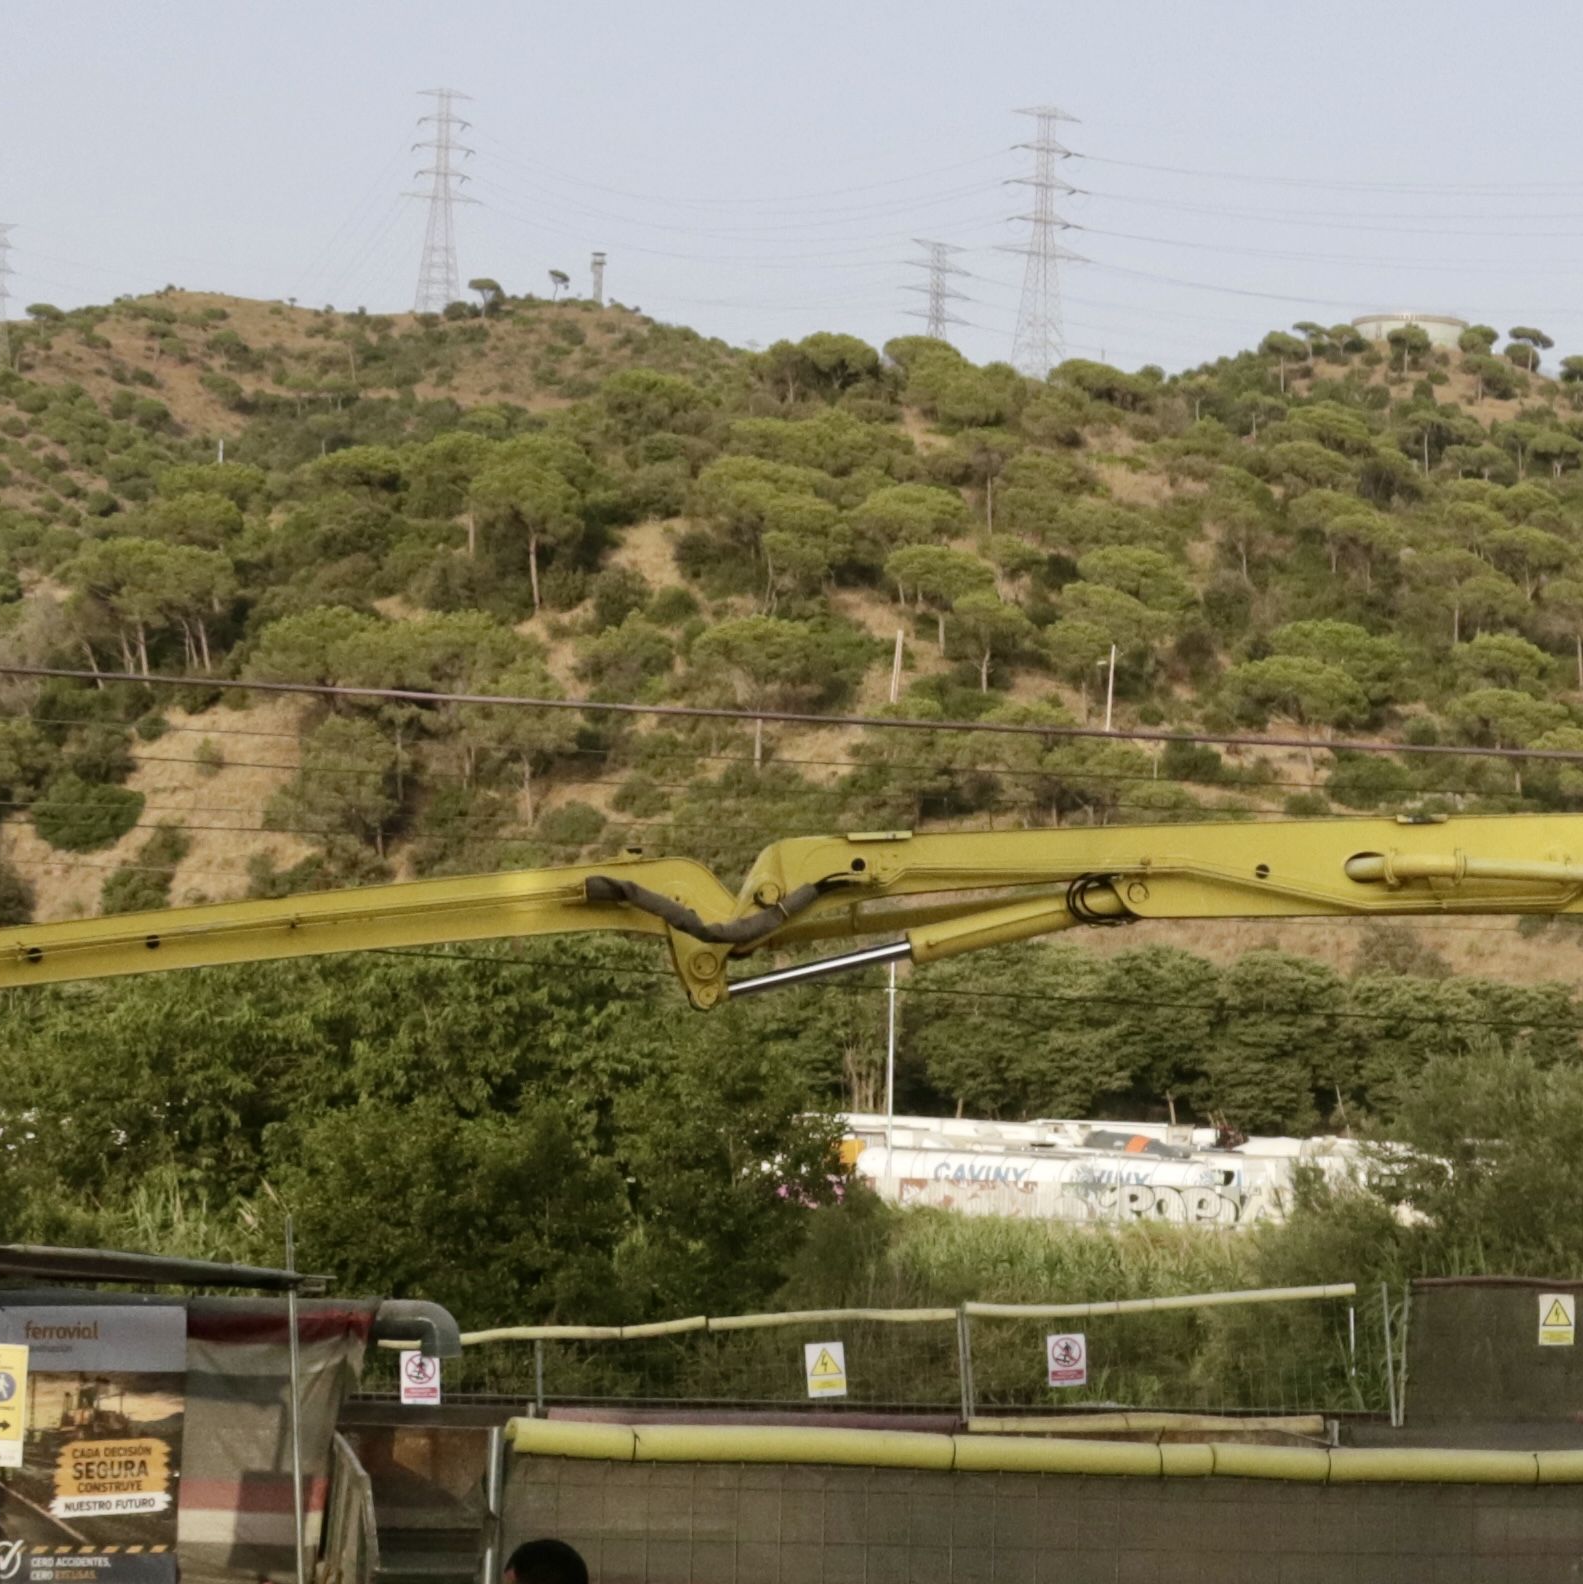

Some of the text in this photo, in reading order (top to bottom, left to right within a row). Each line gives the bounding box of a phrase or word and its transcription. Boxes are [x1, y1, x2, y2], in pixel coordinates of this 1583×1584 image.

[24, 1319, 99, 1340] ferrovial
[71, 1445, 152, 1459] CADA DECISIÓN
[72, 1460, 149, 1480] SEGURA
[77, 1479, 143, 1493] CONSTRUYE
[64, 1498, 156, 1512] NUESTRO FUTURO
[30, 1557, 54, 1568] CERO
[30, 1570, 54, 1581] CERO
